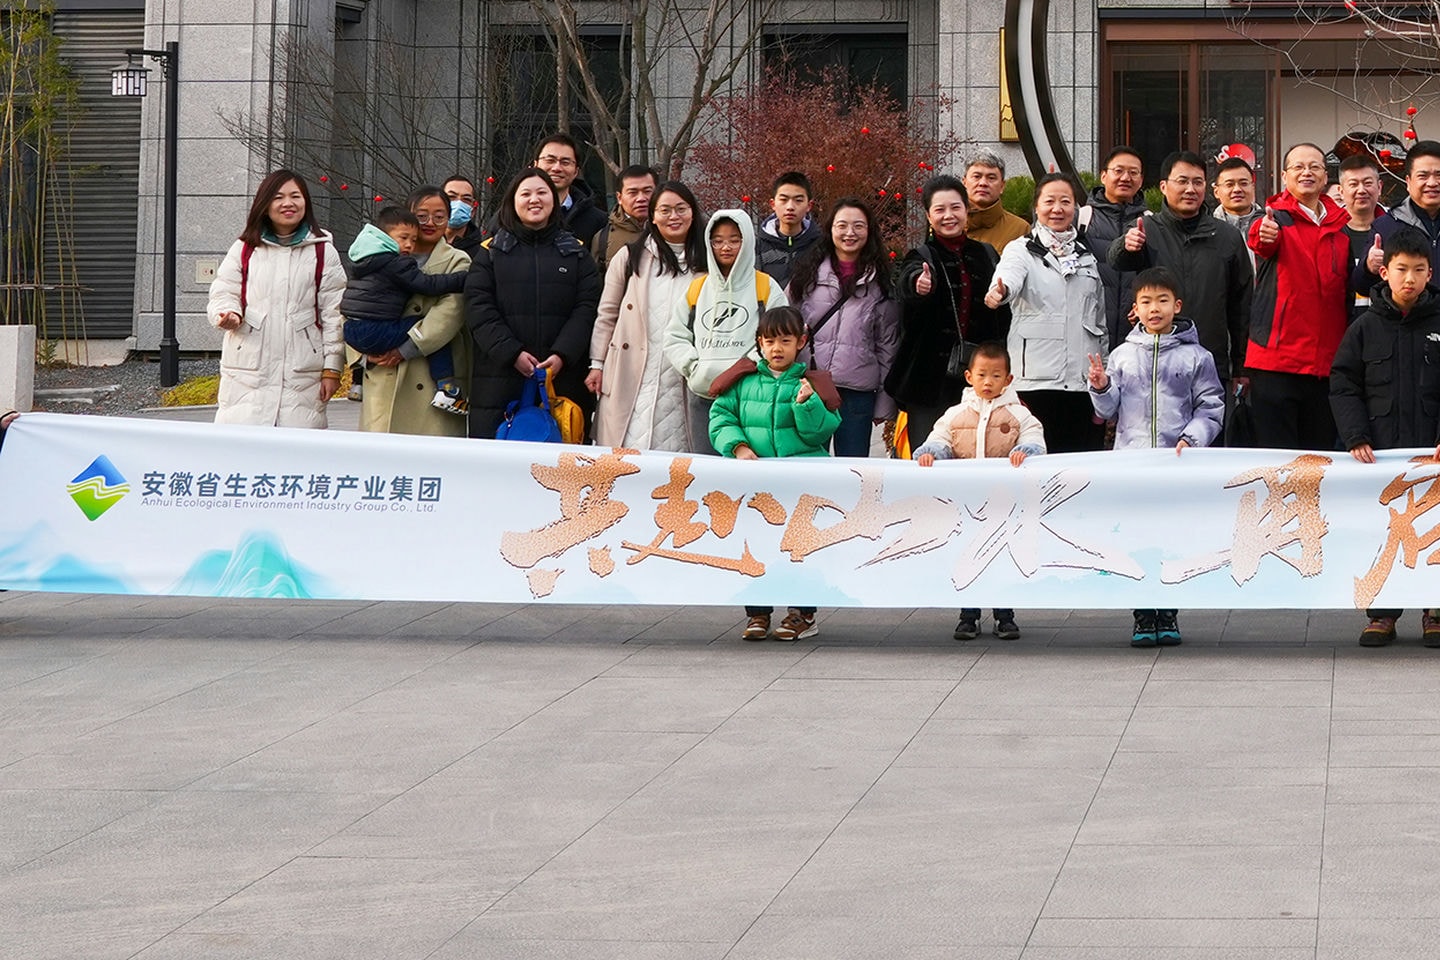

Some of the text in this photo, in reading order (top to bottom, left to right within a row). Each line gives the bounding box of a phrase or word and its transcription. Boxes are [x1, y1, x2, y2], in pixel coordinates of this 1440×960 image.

[141, 470, 443, 502] 安徽省生态环境产业集团
[141, 498, 173, 507] Anhui
[175, 498, 232, 510] Ecological
[234, 499, 304, 510] Environment
[306, 501, 351, 512] Industry
[353, 502, 388, 513] Group
[416, 503, 437, 513] Ltd.
